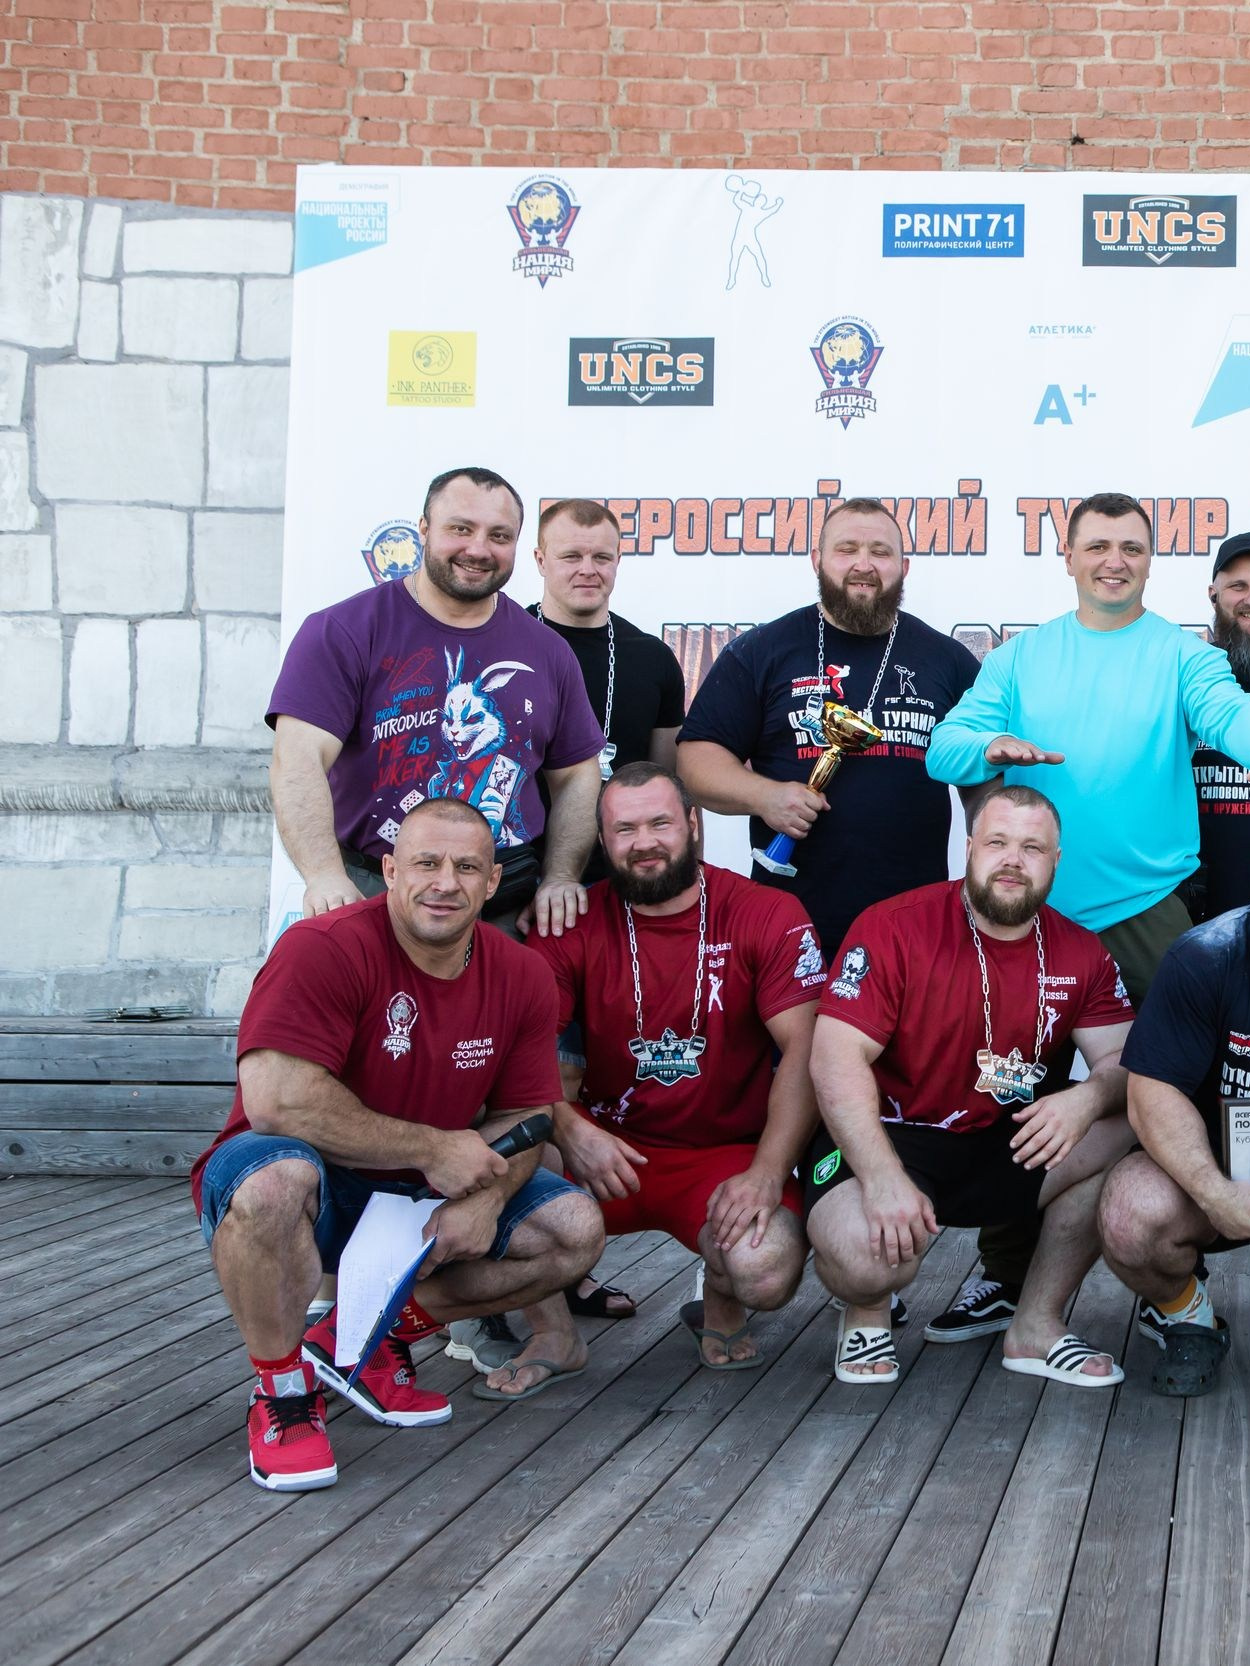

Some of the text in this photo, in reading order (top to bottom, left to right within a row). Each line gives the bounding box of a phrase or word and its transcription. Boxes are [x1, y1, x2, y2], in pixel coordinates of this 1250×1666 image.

[302, 202, 386, 216] НАЦИОНАЛЬНЫЕ
[338, 216, 386, 229] ПРОЕКТЫ
[894, 213, 1015, 237] PRINT 71
[1093, 211, 1226, 245] UNCS
[346, 229, 386, 242] РОССИИ
[894, 239, 1014, 250] ПОЛИГРАФИЧЕСКИЙ ЦЕНТР
[513, 253, 573, 271] НАЦИЯ
[525, 266, 562, 277] МИРА
[578, 353, 704, 385] UNCS
[397, 380, 468, 393] INK PANTHER
[402, 395, 462, 404] TATTOO STUDIO
[816, 395, 877, 412] НАЦИЯ
[827, 408, 864, 418] МИРА
[393, 686, 434, 703] WHEN YOU
[905, 696, 934, 709] strong
[375, 704, 401, 724] BRING
[882, 710, 936, 733] ТУРНИР
[372, 708, 438, 743] INTRODUCE
[795, 731, 808, 745] ПО
[881, 729, 930, 748] ЭКСТРИМУ
[378, 734, 430, 763] ME AS
[1193, 766, 1250, 784] ТКРЫТЫ
[1045, 990, 1068, 1000] ussia
[639, 1059, 697, 1075] STRONGMAN
[1235, 1119, 1250, 1129] ПО
